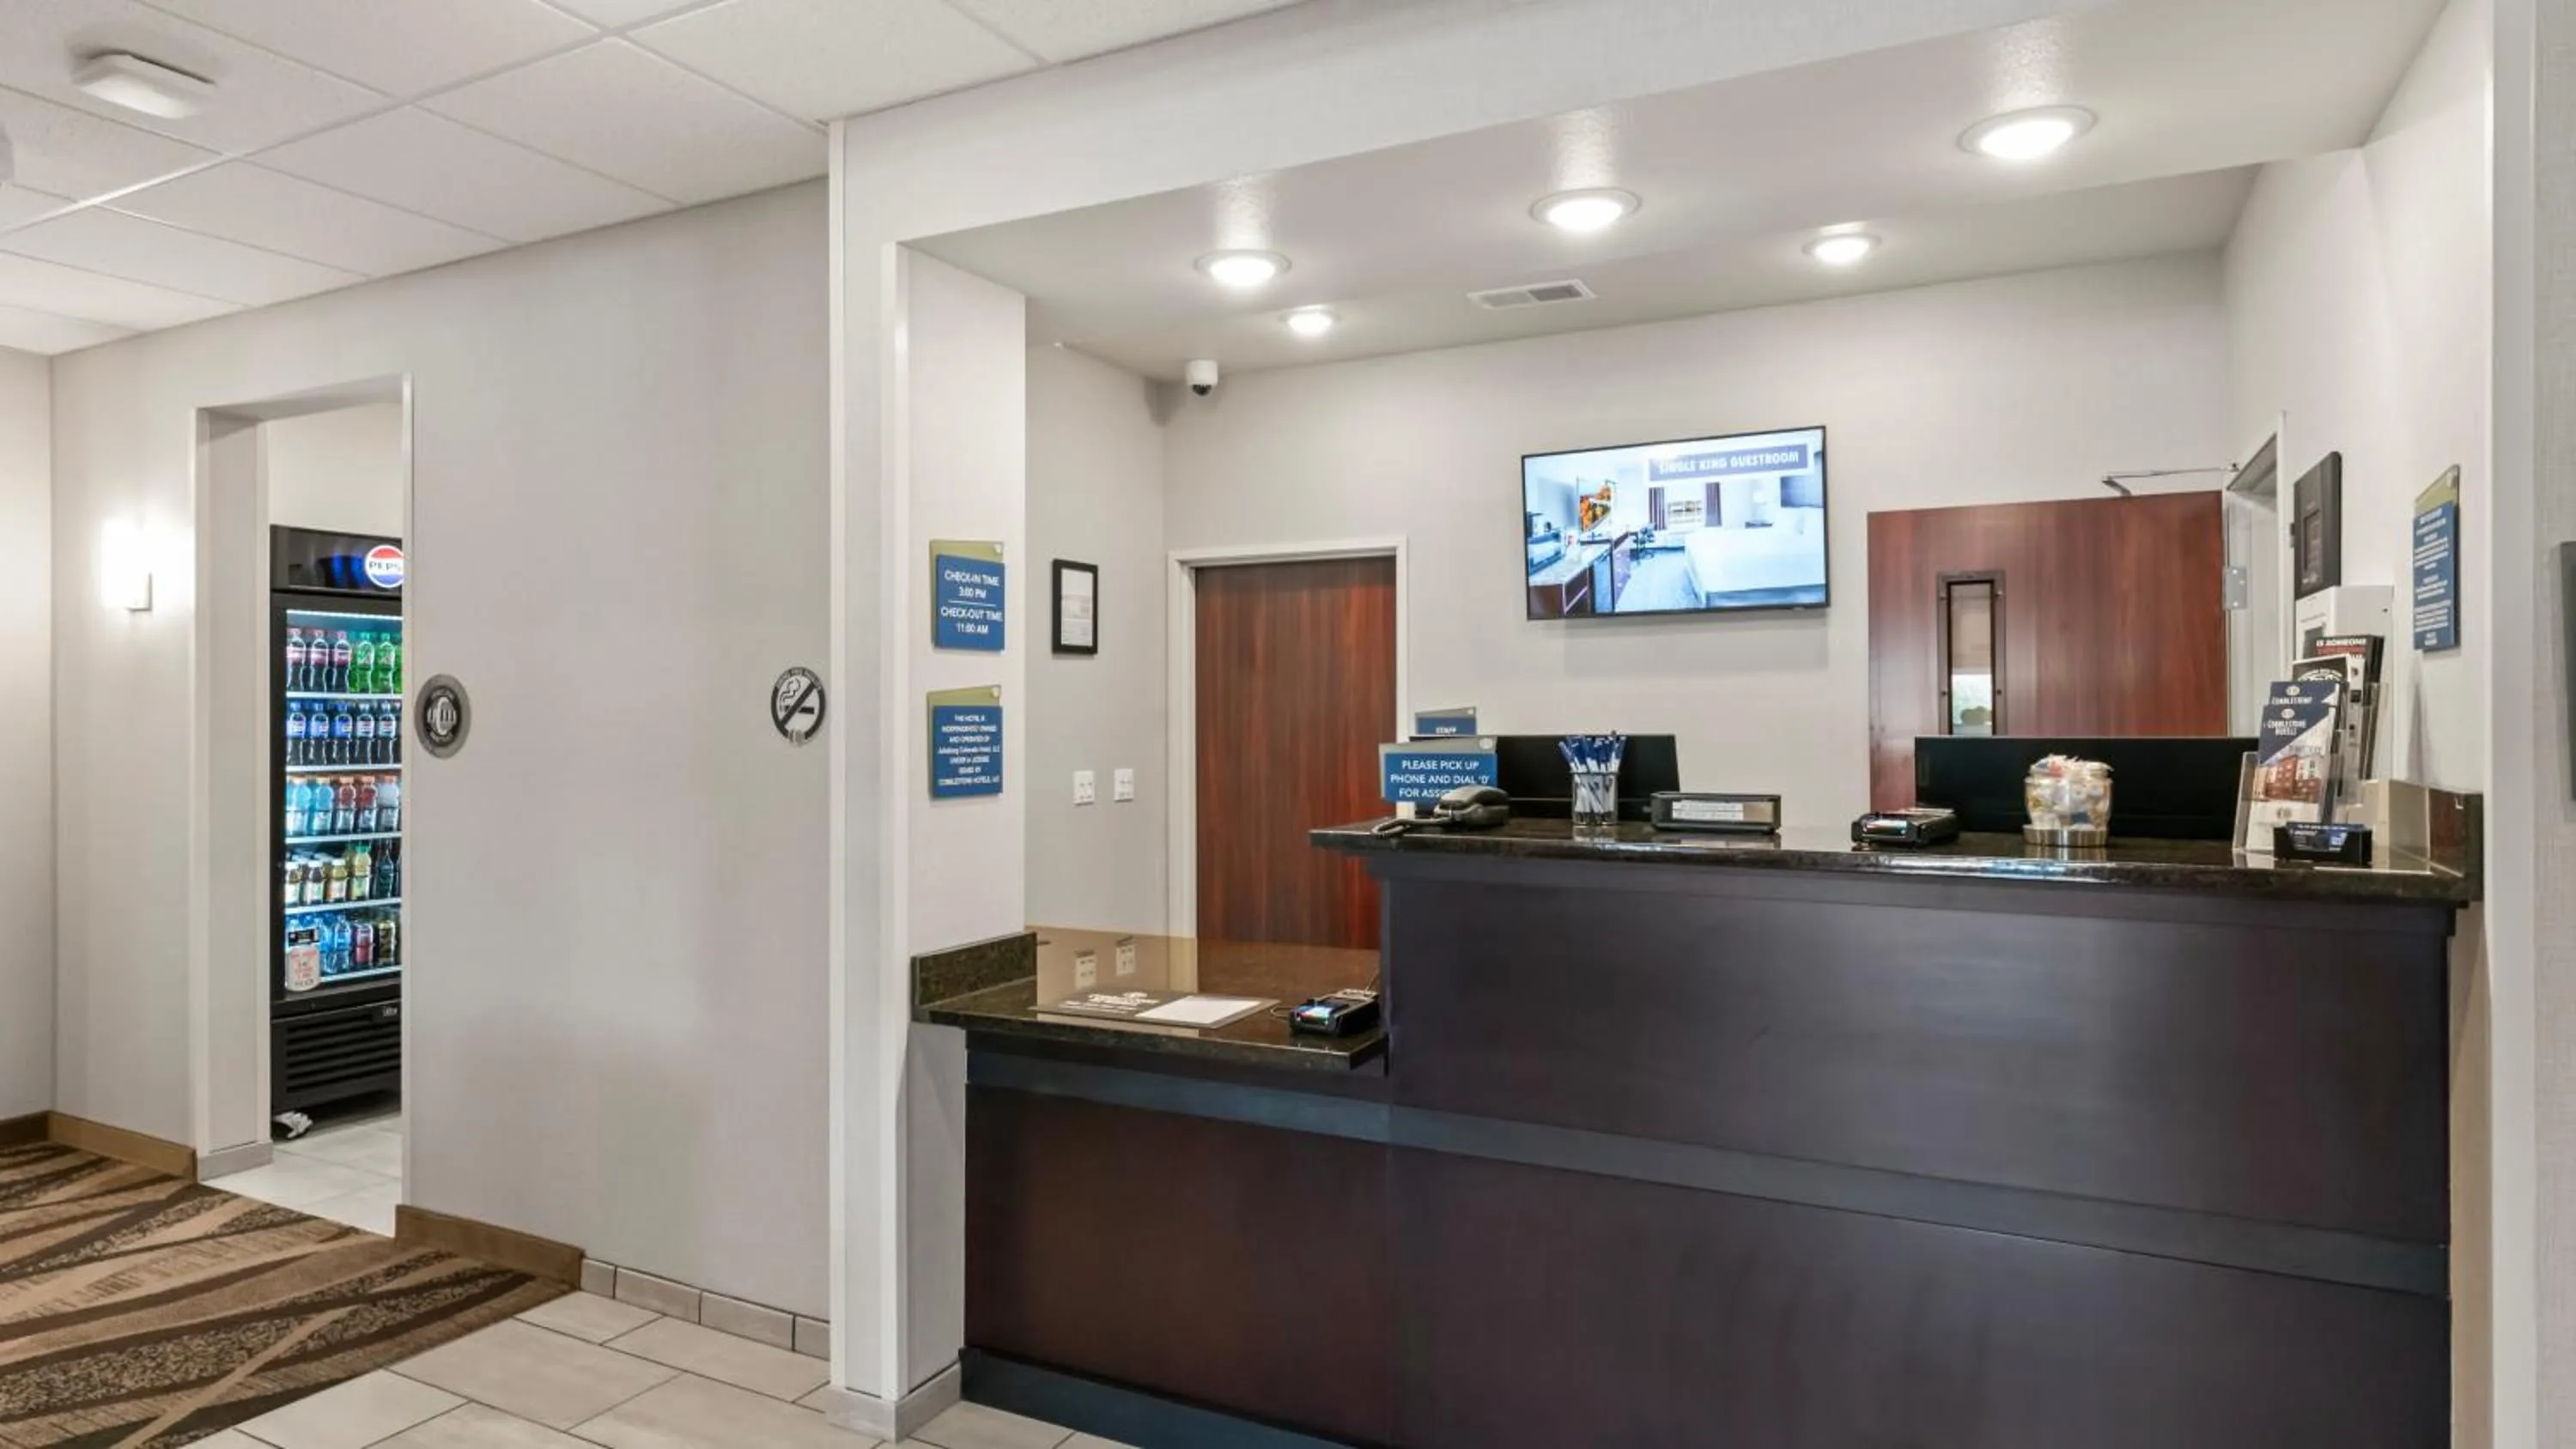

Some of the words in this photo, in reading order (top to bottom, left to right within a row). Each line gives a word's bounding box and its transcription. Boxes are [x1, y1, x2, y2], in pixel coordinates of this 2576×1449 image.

[1699, 456, 1727, 470] KING
[1730, 451, 1799, 467] GUESTROOM
[944, 570, 981, 584] CHECK-IN
[982, 574, 1000, 586] TIME
[975, 588, 987, 599] PM
[940, 606, 985, 620] CHECK-OUT
[986, 610, 1004, 622] TIME
[977, 624, 989, 634] AM
[1401, 760, 1438, 771] PLEASE
[1440, 760, 1462, 770] PICK
[1464, 760, 1480, 770] UP
[1390, 773, 1425, 785] PHONE
[1428, 774, 1451, 784] AND
[1453, 774, 1476, 785] DIAL
[1399, 787, 1420, 797] FOR
